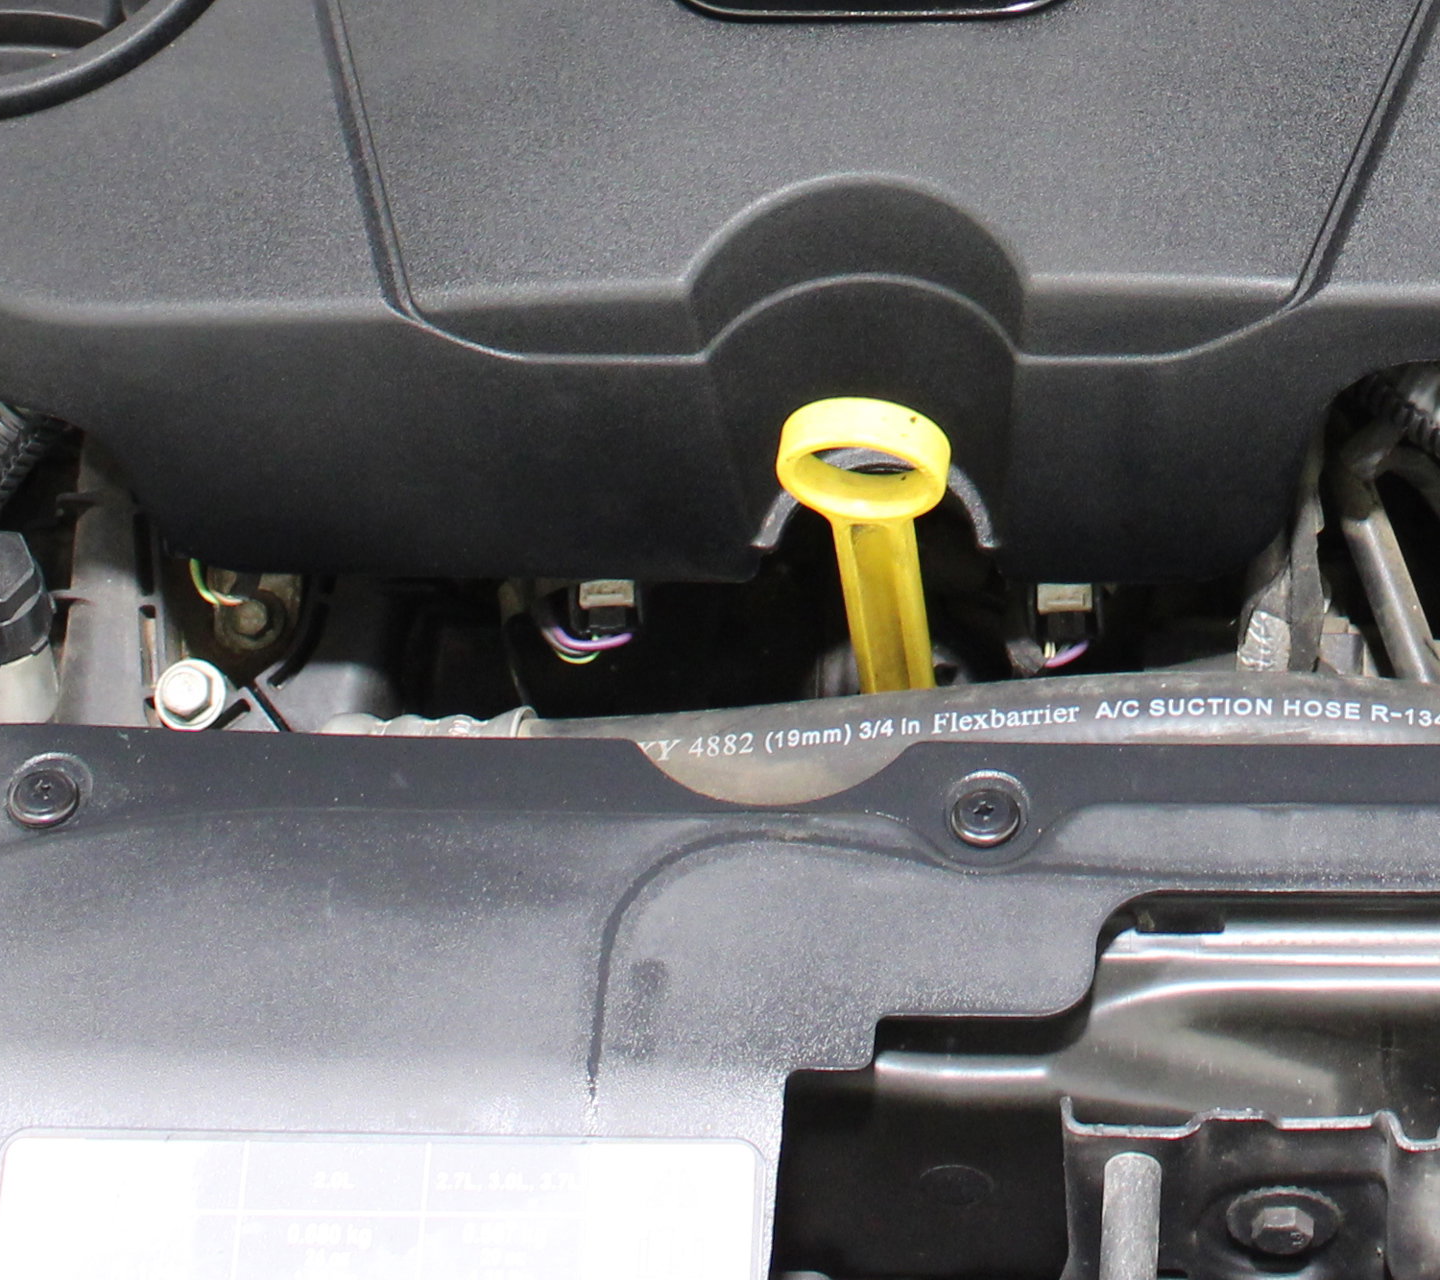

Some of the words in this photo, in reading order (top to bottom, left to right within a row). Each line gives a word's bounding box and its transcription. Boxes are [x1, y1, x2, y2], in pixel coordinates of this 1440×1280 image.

[687, 731, 756, 758] 4882
[763, 722, 853, 755] (19mm)
[858, 718, 896, 741] 3/4
[931, 702, 1082, 735] Flexbarrier
[1094, 697, 1142, 720] A/C
[1148, 696, 1274, 719] SUCTION
[1282, 698, 1362, 721] HOSE
